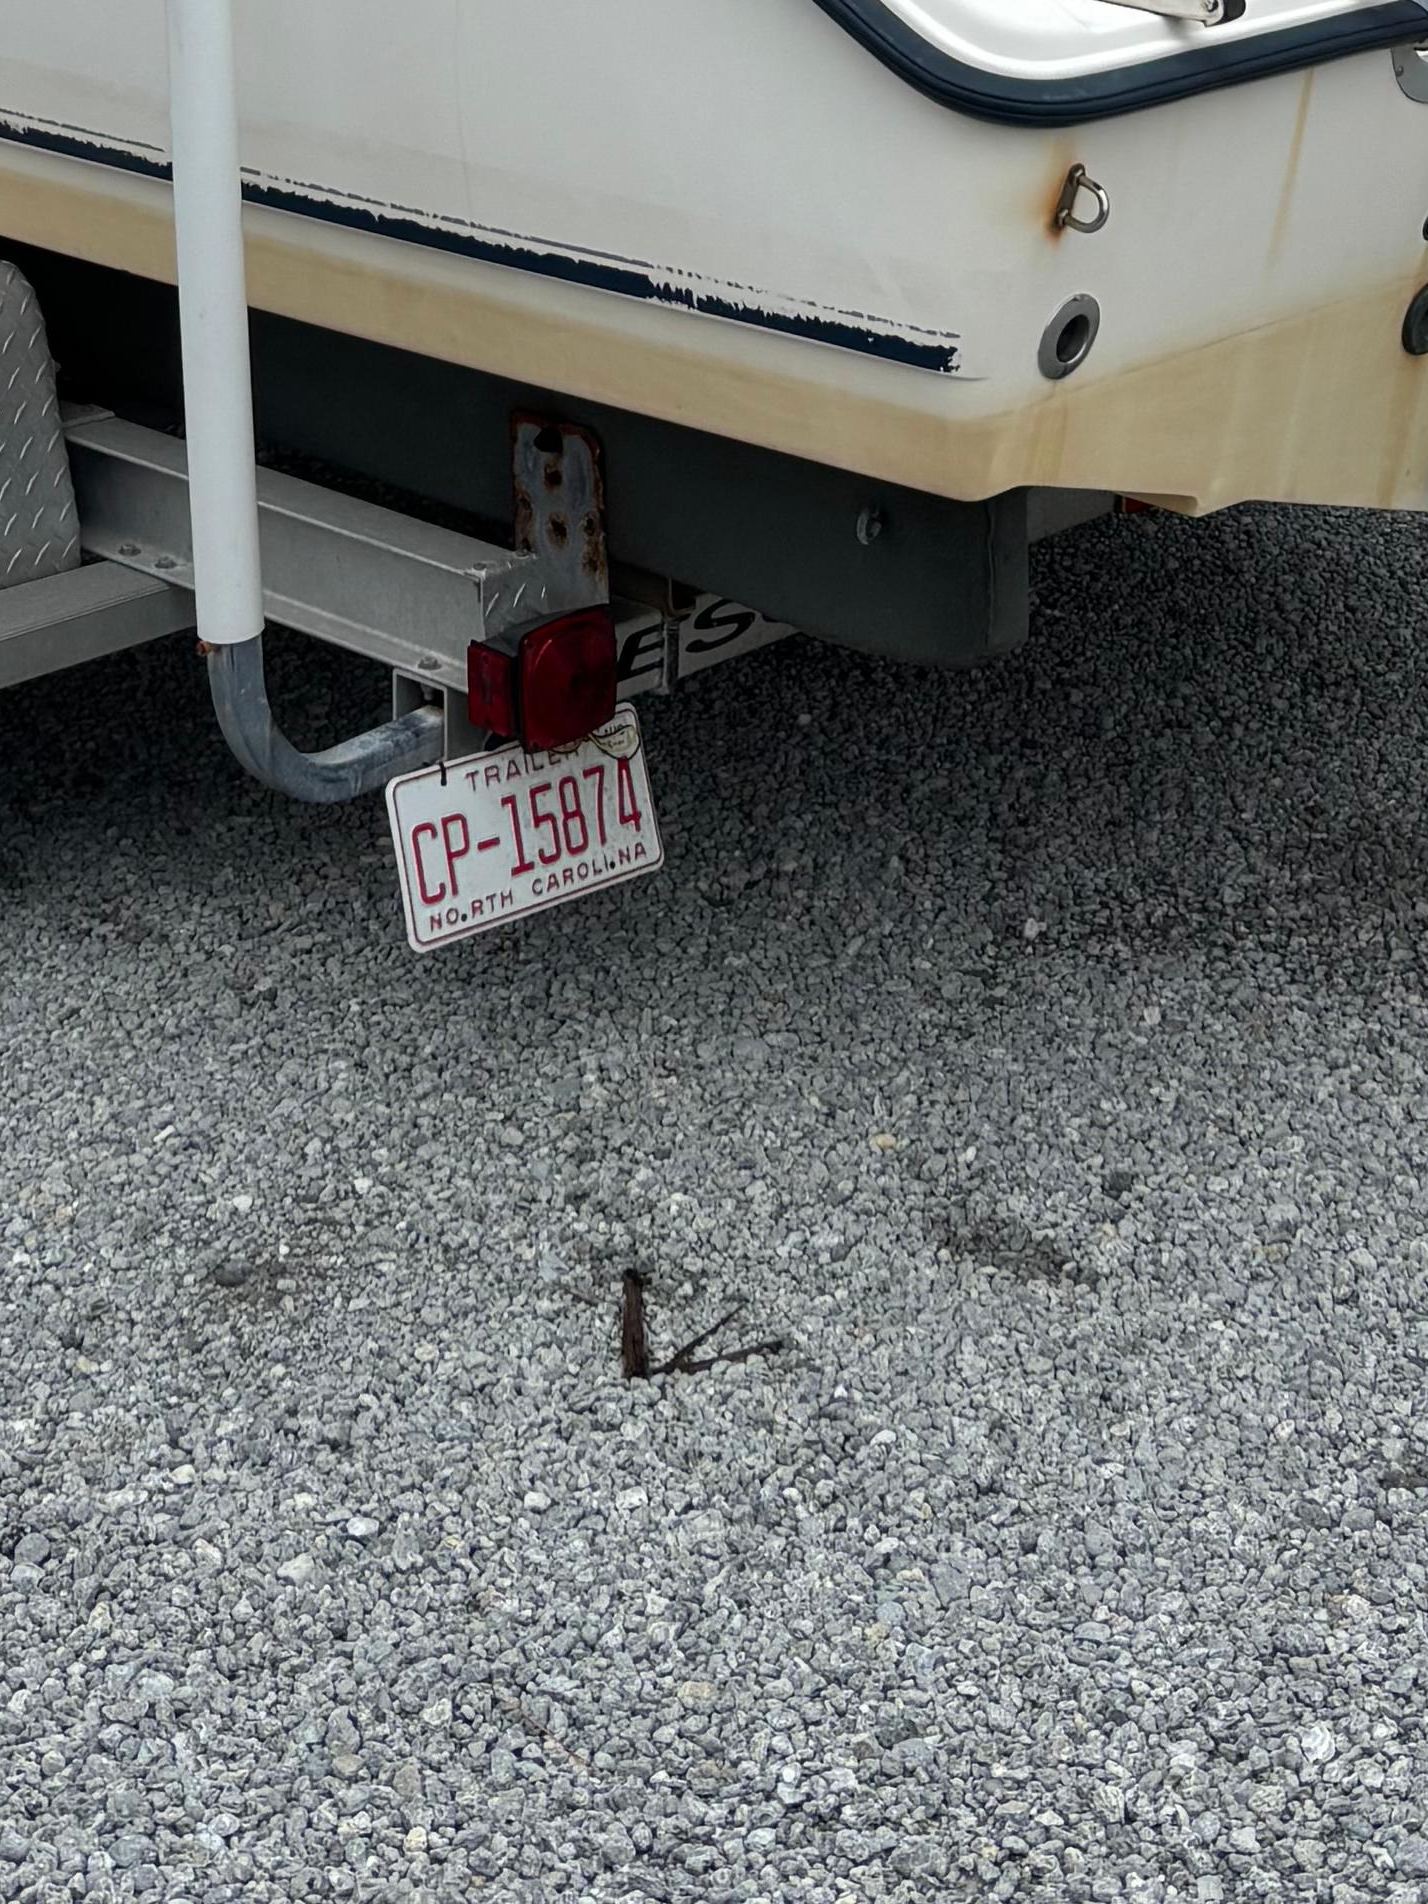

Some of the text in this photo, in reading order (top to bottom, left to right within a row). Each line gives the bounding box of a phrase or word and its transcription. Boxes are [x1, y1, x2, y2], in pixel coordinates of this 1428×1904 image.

[411, 756, 643, 907] CP-15874
[429, 841, 648, 933] NORTH CAROLINA
